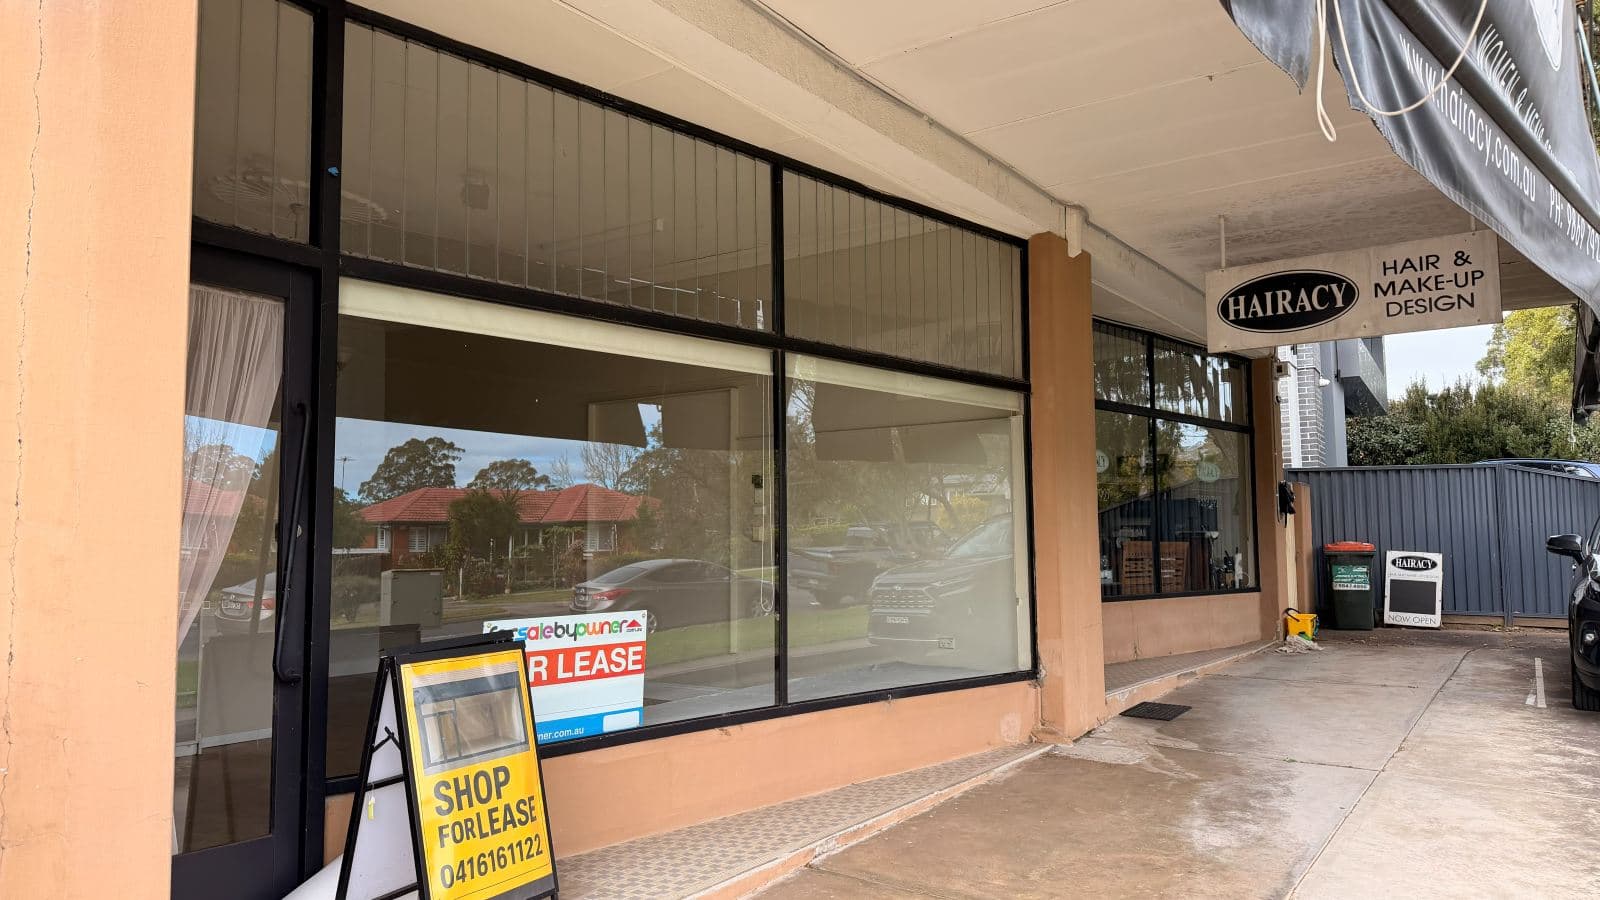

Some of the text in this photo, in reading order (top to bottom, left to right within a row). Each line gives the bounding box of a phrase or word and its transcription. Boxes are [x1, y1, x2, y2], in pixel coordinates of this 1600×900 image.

[1399, 33, 1536, 203] www.hairacy.com.au
[1382, 250, 1473, 276] HAIR &
[1374, 269, 1485, 298] MAKE-UP
[1227, 282, 1348, 321] HAIRACY
[1386, 292, 1475, 317] DESIGN
[1395, 557, 1433, 570] HAIRACY
[489, 618, 629, 642] salebyowner
[1388, 614, 1436, 625] NOW OPEN
[557, 645, 643, 679] LEASE
[433, 765, 511, 817] SHOP
[440, 833, 543, 889] 0416161122
